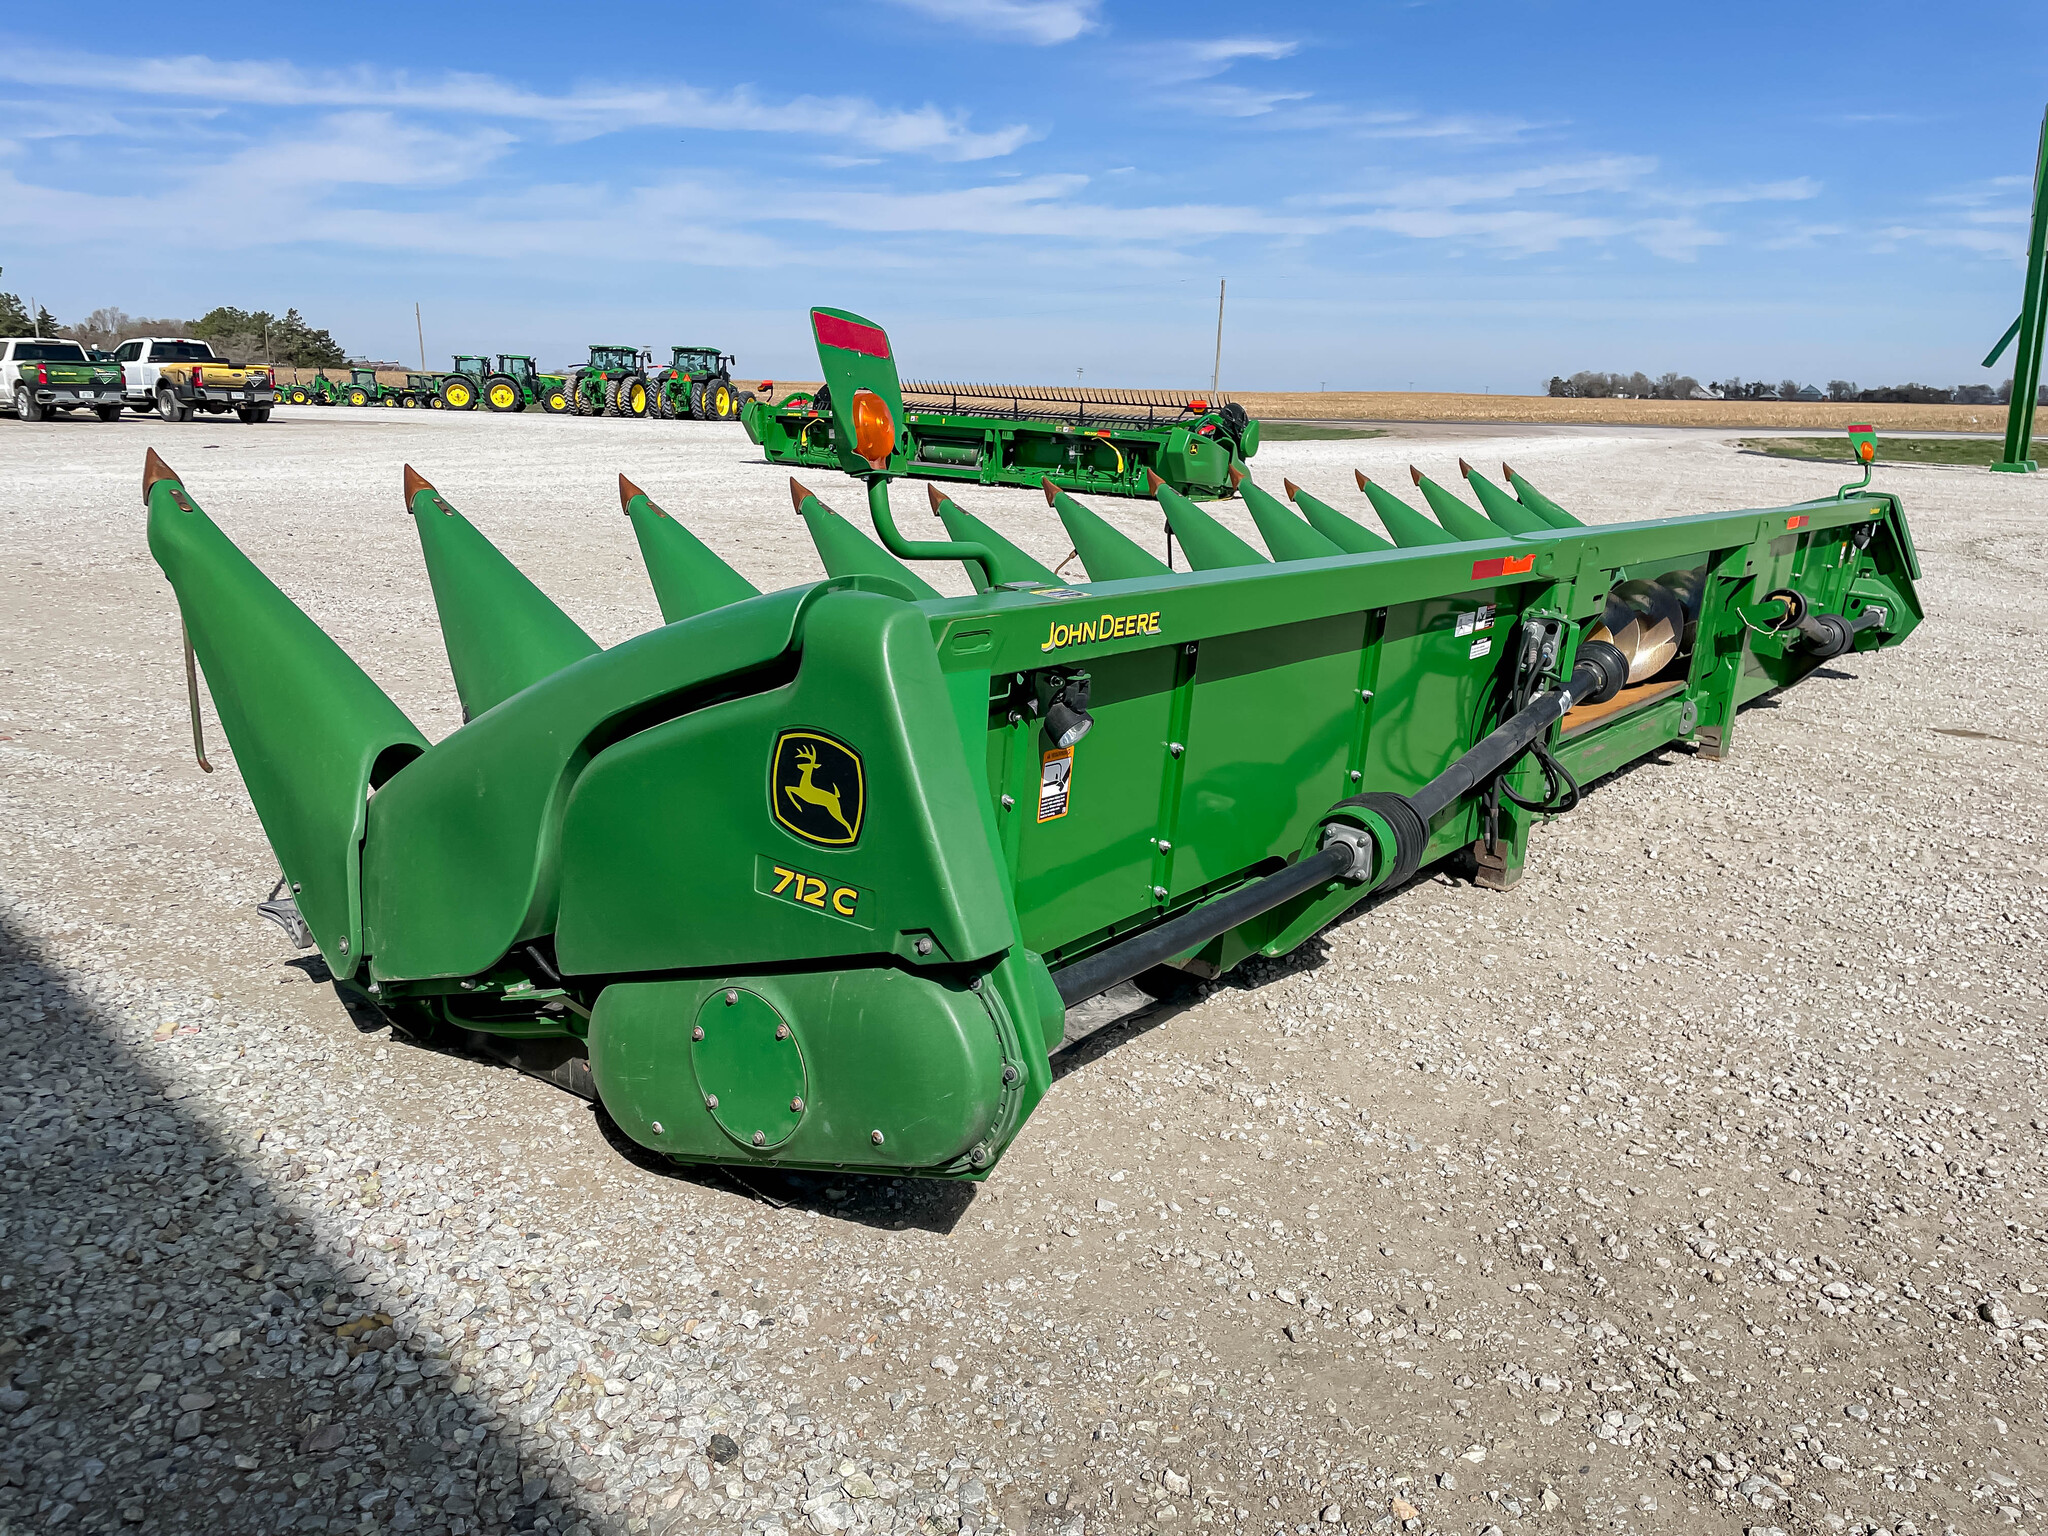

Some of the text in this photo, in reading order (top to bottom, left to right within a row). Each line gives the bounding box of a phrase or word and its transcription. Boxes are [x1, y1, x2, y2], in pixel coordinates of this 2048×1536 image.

[1041, 611, 1161, 651] JOHN DEERE
[772, 865, 860, 917] 712 C
